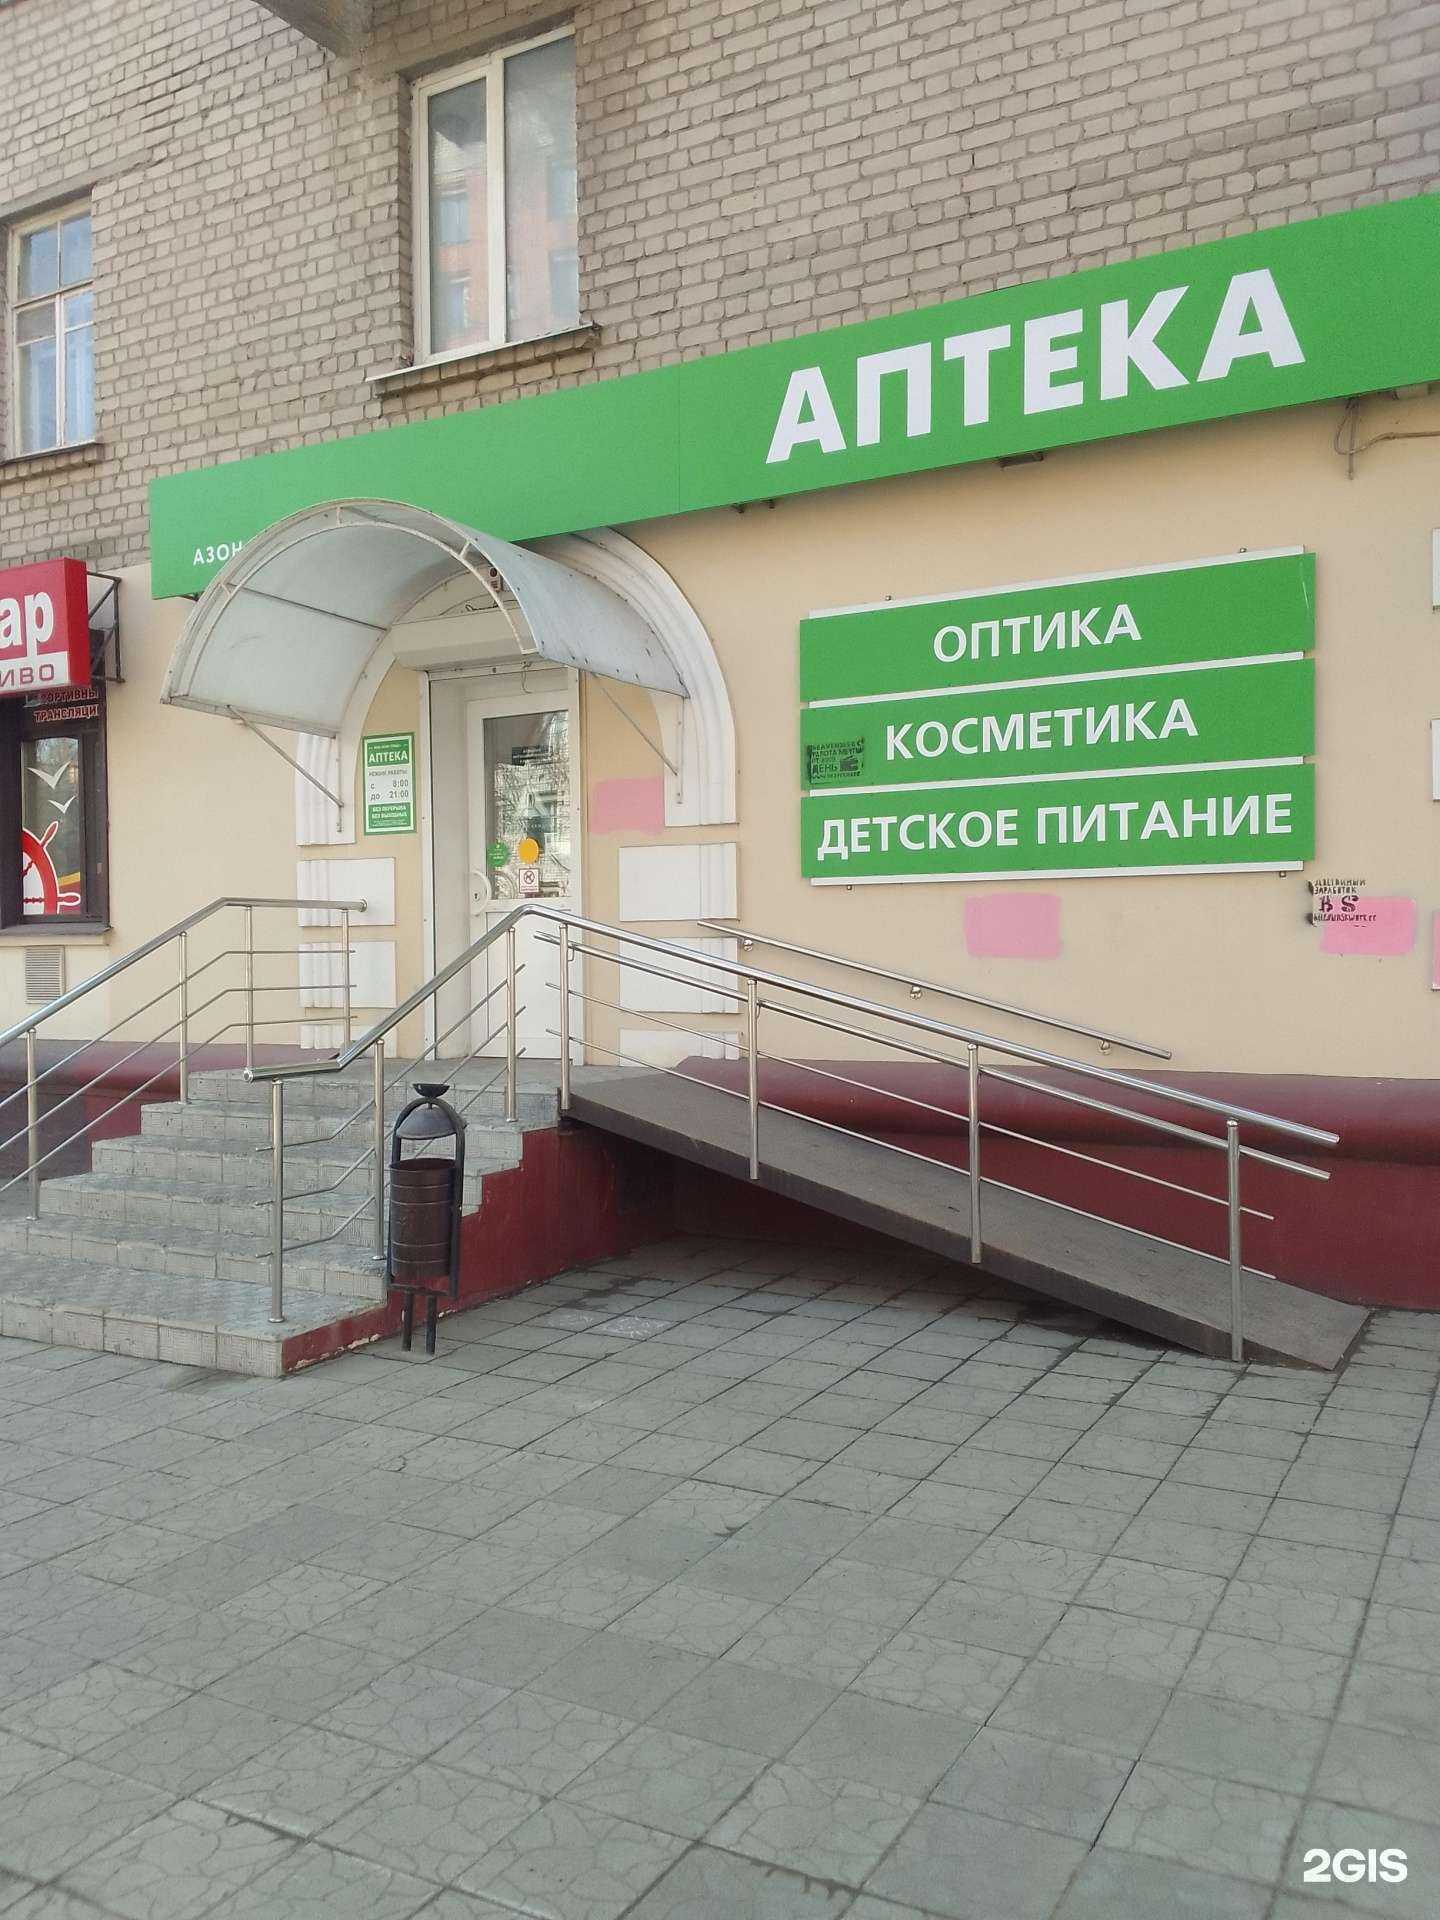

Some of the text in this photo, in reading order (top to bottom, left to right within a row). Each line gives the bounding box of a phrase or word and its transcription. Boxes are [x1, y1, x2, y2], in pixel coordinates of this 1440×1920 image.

[766, 268, 1306, 464] АПТЕКА
[933, 604, 1142, 663] ОПТИКА
[369, 750, 408, 763] АПТЕКА
[886, 698, 1199, 761] КОСМЕТИКА
[389, 790, 409, 799] 21:00
[392, 779, 409, 788] 8:00
[817, 793, 1292, 860] ДЕТСКОЕ ПИТАНИЕ
